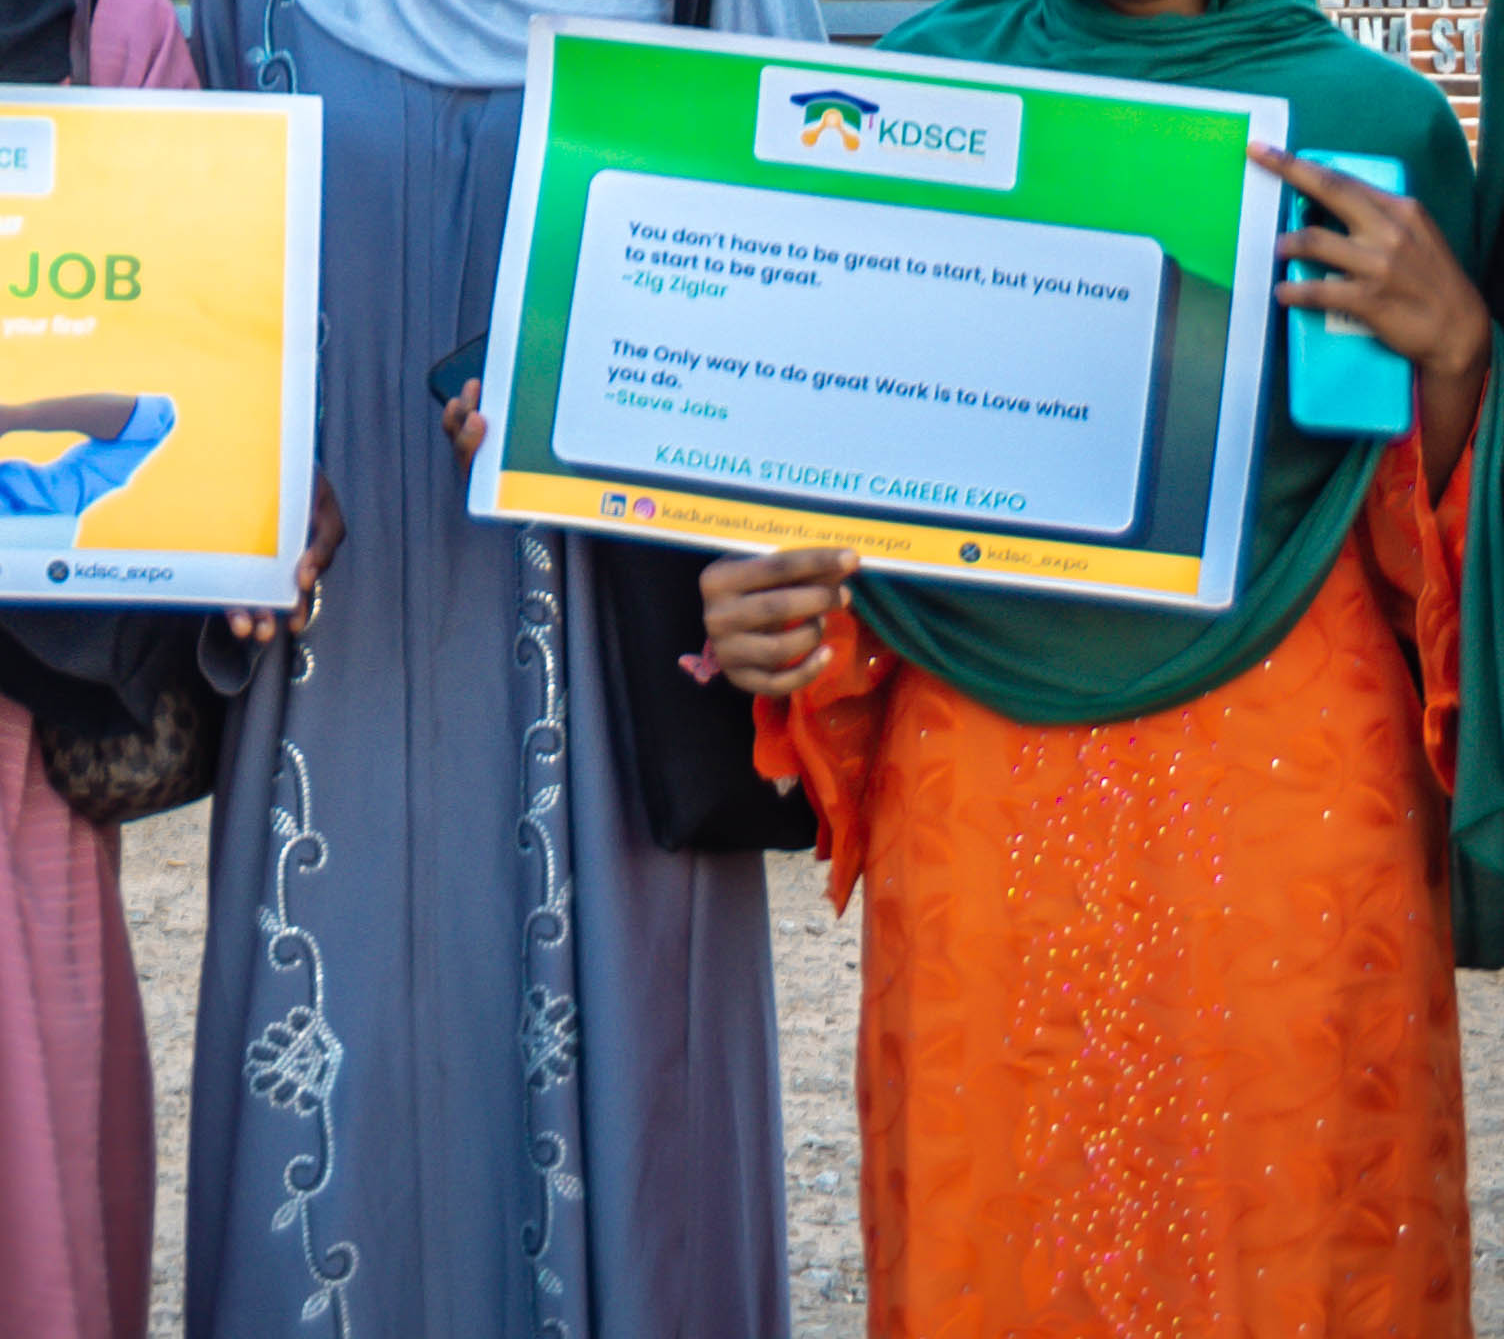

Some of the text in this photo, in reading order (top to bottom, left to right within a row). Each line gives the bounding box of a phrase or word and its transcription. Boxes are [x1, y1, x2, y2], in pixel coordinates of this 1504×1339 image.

[879, 118, 988, 155] KDSCE
[8, 251, 142, 302] JOB
[625, 245, 822, 287] to start to be great.
[629, 220, 667, 242] You
[730, 234, 782, 256] have
[787, 243, 808, 261] to
[813, 245, 839, 263] be
[844, 250, 900, 272] great
[906, 257, 927, 275] to
[932, 261, 986, 285] start,
[991, 268, 1028, 289] but
[1032, 276, 1071, 297] you
[1076, 279, 1130, 302] have
[669, 273, 728, 299] Ziglar
[3, 317, 48, 339] your
[607, 366, 682, 389] you do.
[612, 338, 1089, 422] The Only way to do great Work is to Love what
[679, 397, 728, 420] Jobs
[655, 444, 1027, 512] KADUNA STUDENT CAREER EXPO
